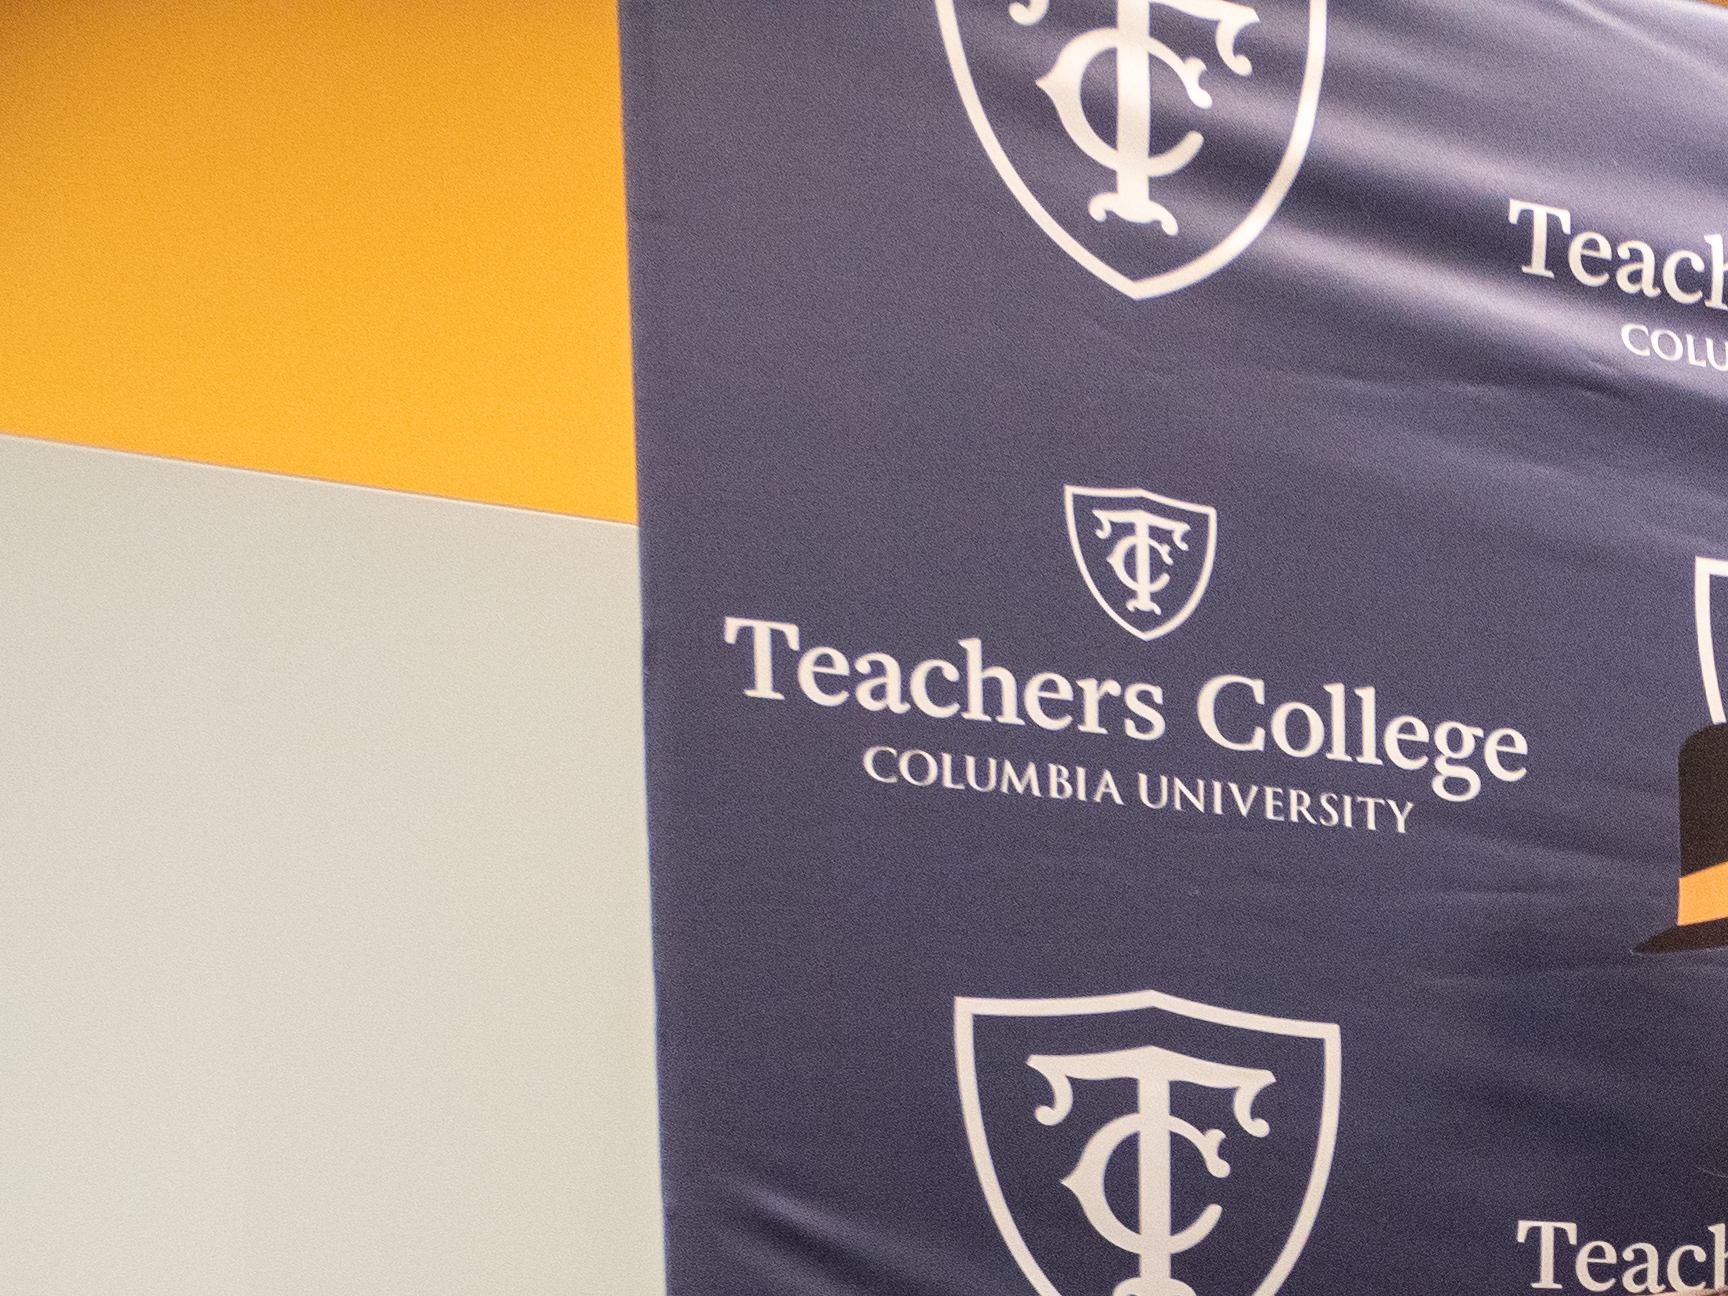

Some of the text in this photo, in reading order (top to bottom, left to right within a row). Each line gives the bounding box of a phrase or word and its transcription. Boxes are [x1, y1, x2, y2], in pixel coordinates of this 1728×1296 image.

[724, 615, 1529, 800] Teachers College
[863, 745, 1415, 834] COLUMBIA UNIVERSITY
